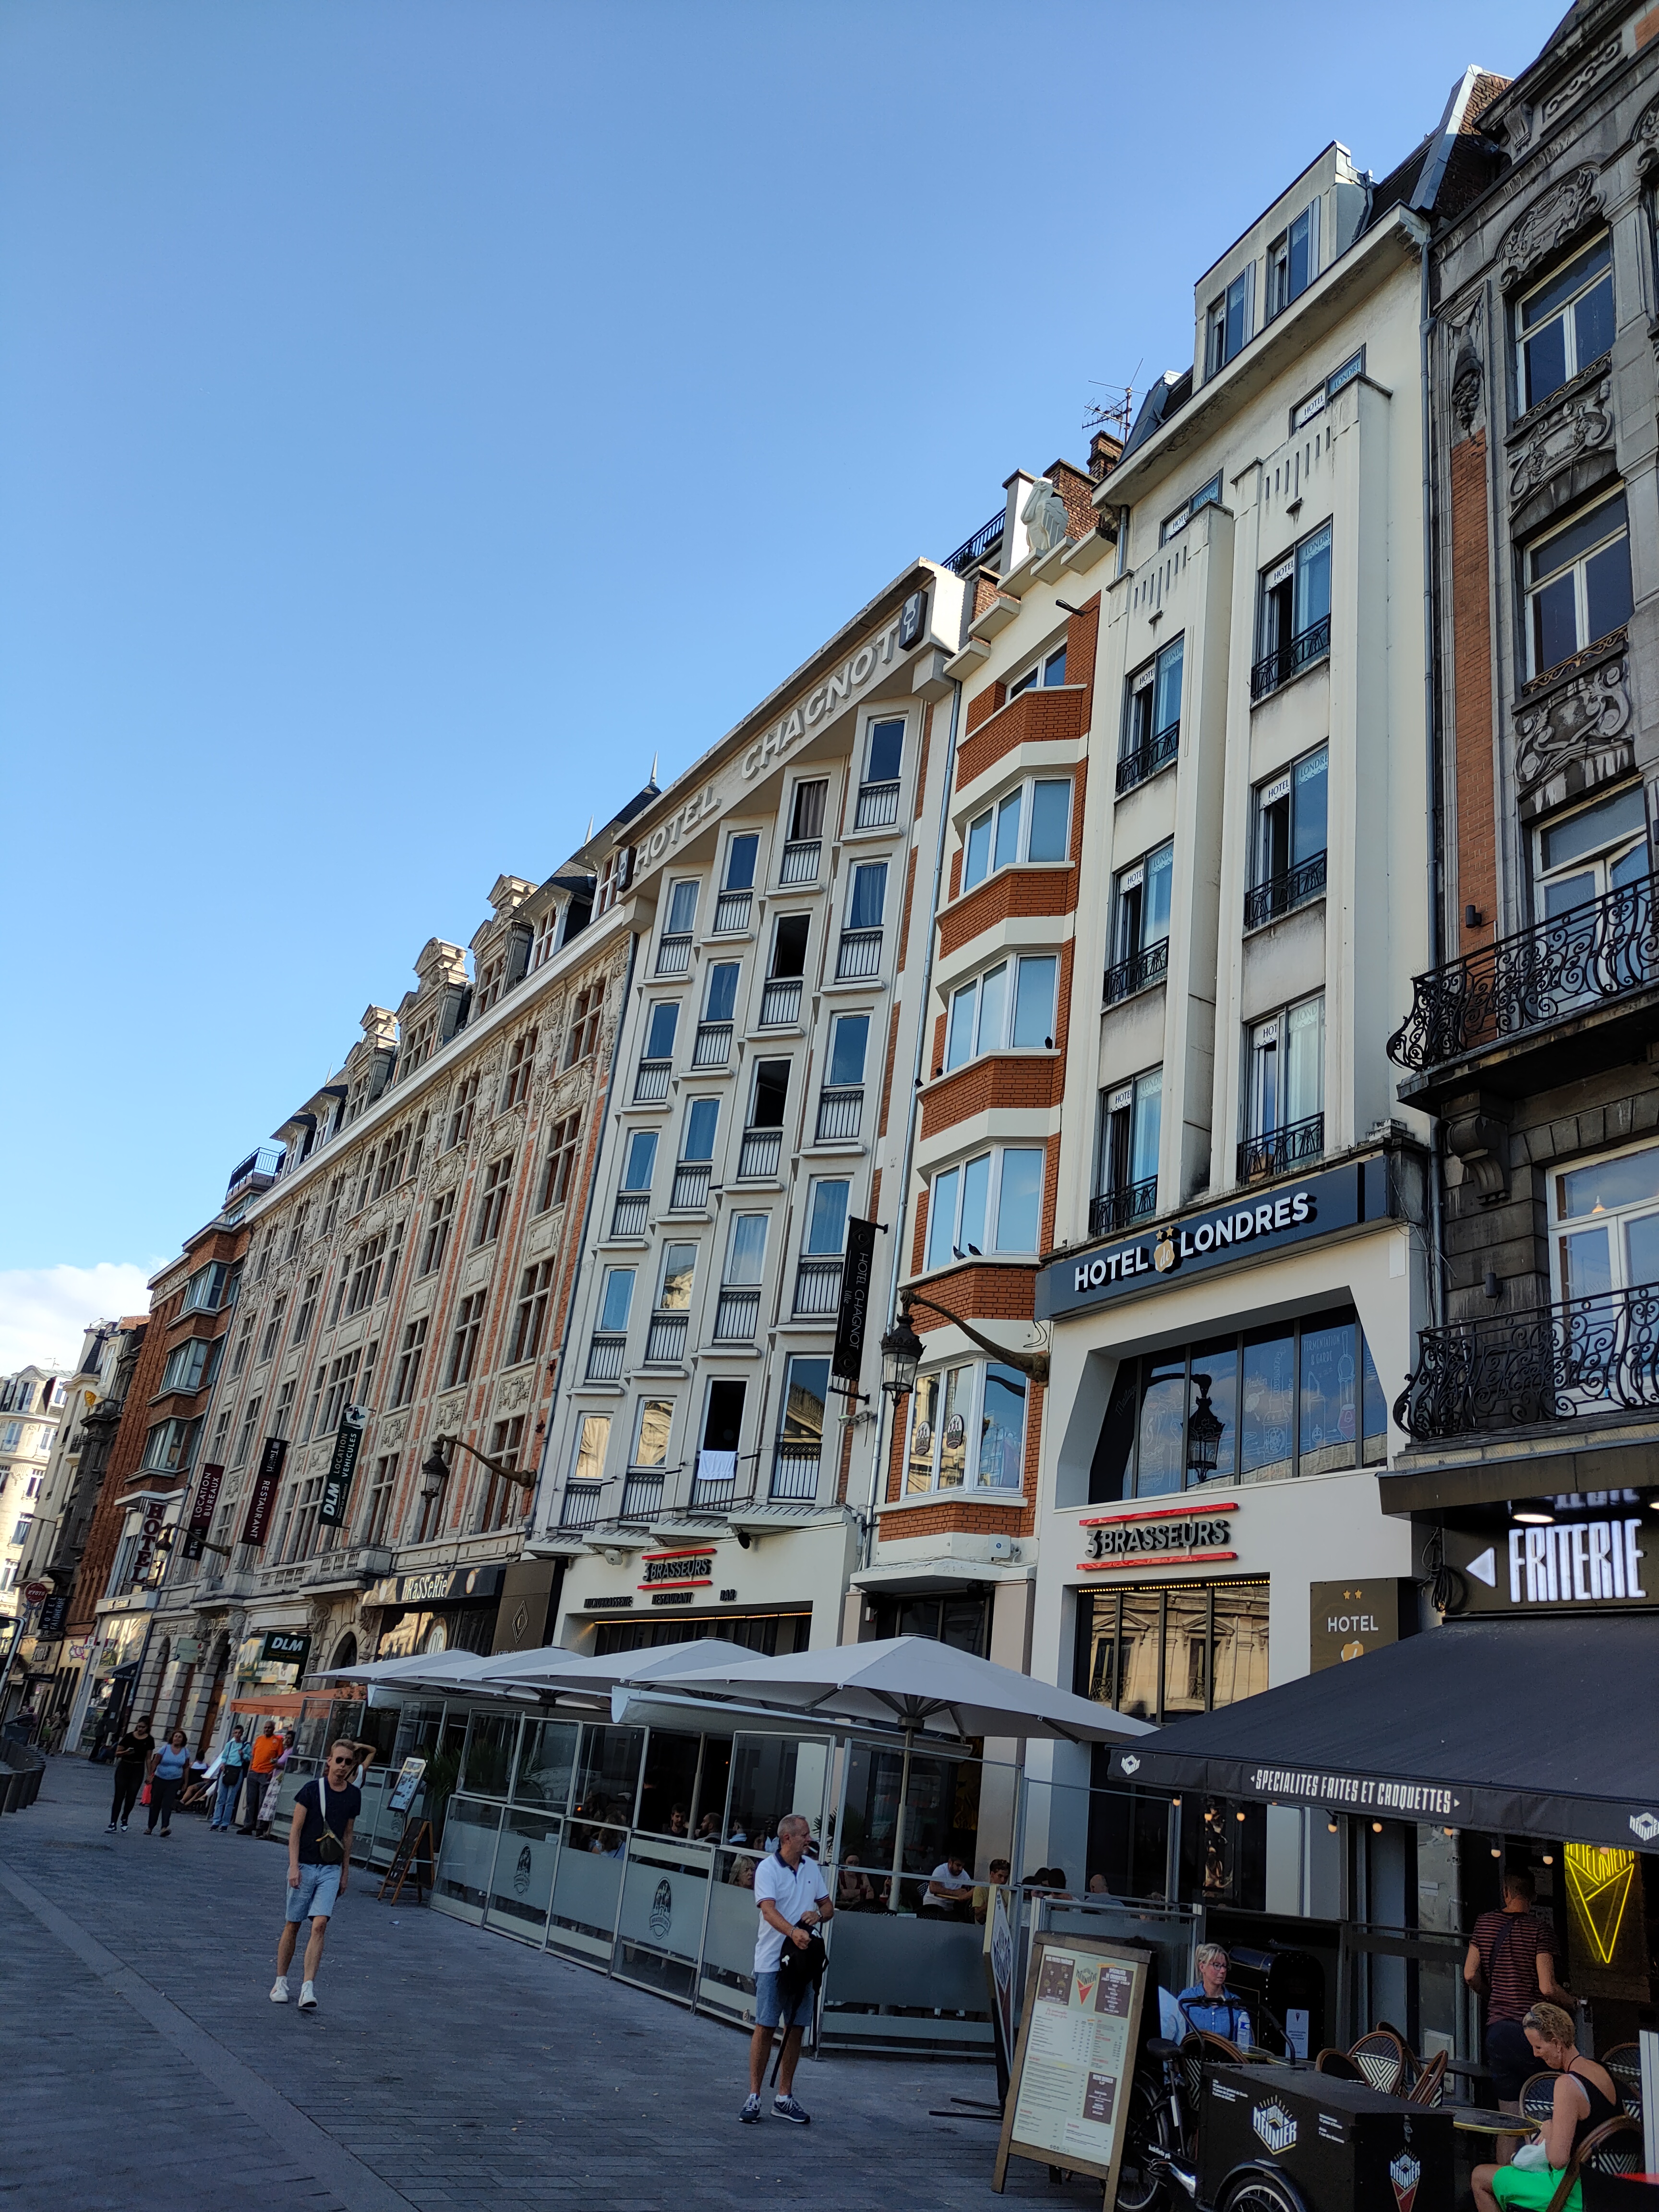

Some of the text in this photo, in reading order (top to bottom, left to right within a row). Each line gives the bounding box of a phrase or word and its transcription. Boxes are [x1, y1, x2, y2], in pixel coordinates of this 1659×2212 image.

[1304, 395, 1324, 416] HOTEL
[1274, 560, 1294, 581] HOTEL
[633, 617, 901, 876] HOTEL CHAGNOT
[1268, 780, 1289, 799] HOTEL
[1075, 1192, 1309, 1291] HOTEL de LONDRES
[844, 1290, 853, 1304] lille
[849, 1252, 868, 1350] HOTEL CHAGNOT
[333, 1433, 348, 1474] LOCATION
[342, 1433, 357, 1478] VEHICULES
[194, 1472, 212, 1518] LOCATION
[204, 1477, 220, 1517] BUREAUX
[250, 1480, 270, 1539] RESTAURANT
[323, 1482, 340, 1516] DLM
[131, 1503, 166, 1584] HOTEL
[1508, 1518, 1647, 1603] FRITERIE
[42, 1597, 57, 1629] HOTEL
[651, 1592, 693, 1605] RESTAURANT
[720, 1589, 736, 1601] BAR
[1328, 1615, 1379, 1632] HOTEL
[271, 1637, 304, 1651] DLM
[1256, 1769, 1451, 1814] SPECIALITES FRITES ET CROQUETTES
[1253, 2106, 1297, 2151] MEUNIER
[1390, 2161, 1420, 2189] MEUNIER
